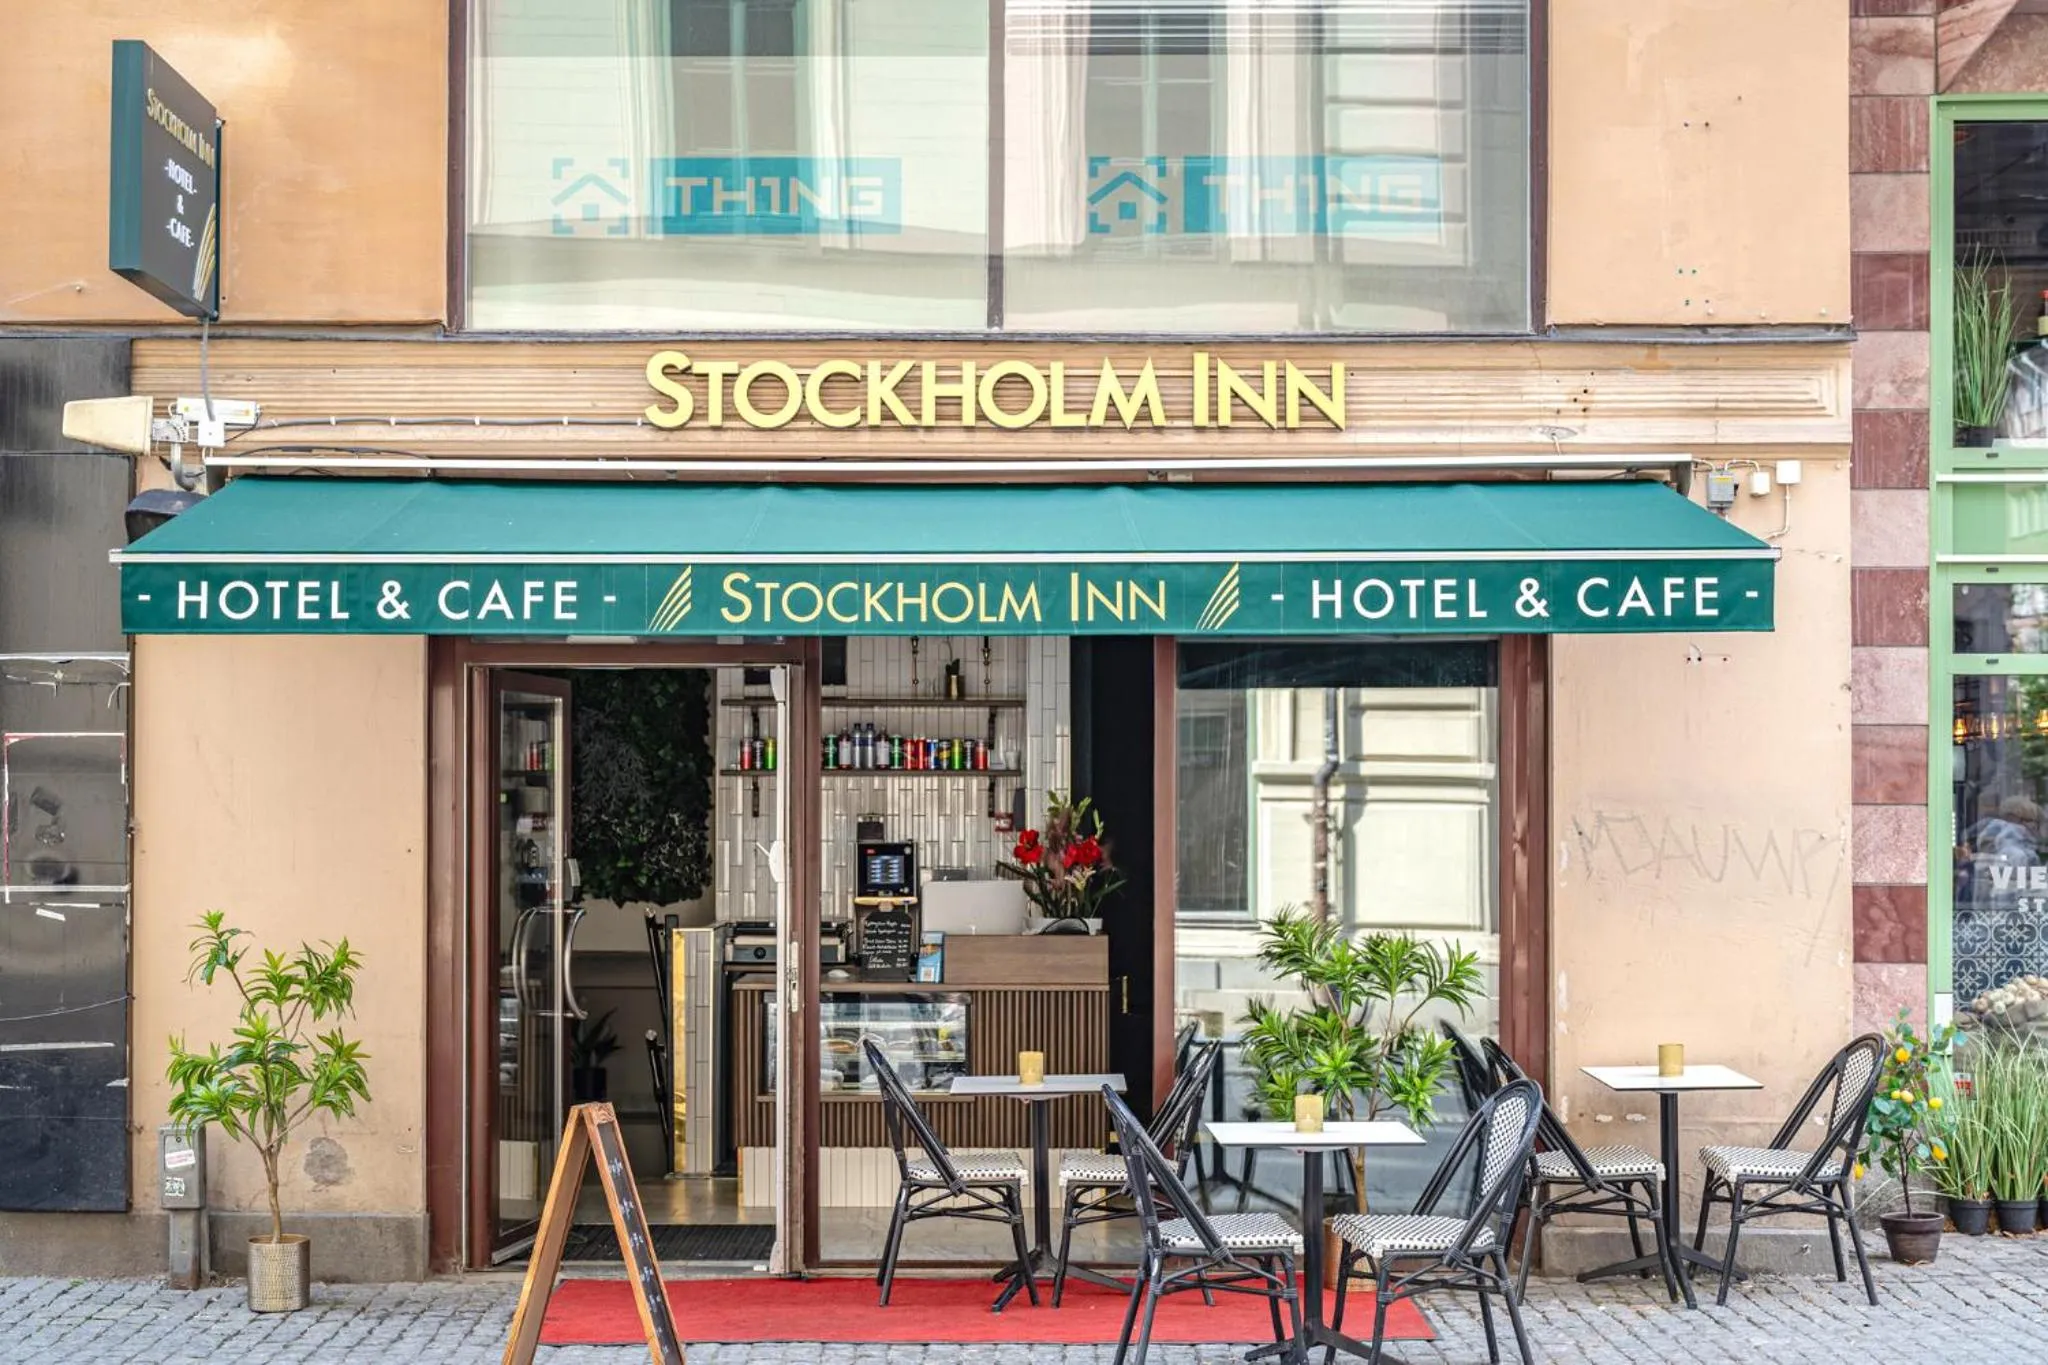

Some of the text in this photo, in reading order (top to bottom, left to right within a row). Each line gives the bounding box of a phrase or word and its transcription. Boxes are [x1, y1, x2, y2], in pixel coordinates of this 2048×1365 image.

[176, 194, 184, 215] &
[644, 351, 1347, 431] STOCKHOLM INN
[178, 581, 350, 621] HOTEL
[377, 581, 411, 620] &
[438, 581, 578, 621] CAFE
[721, 572, 1166, 624] STOCKHOLM INN
[1312, 579, 1488, 620] HOTEL
[1516, 578, 1550, 618] &
[1578, 577, 1719, 618] CAFE
[2018, 898, 2046, 913] ST
